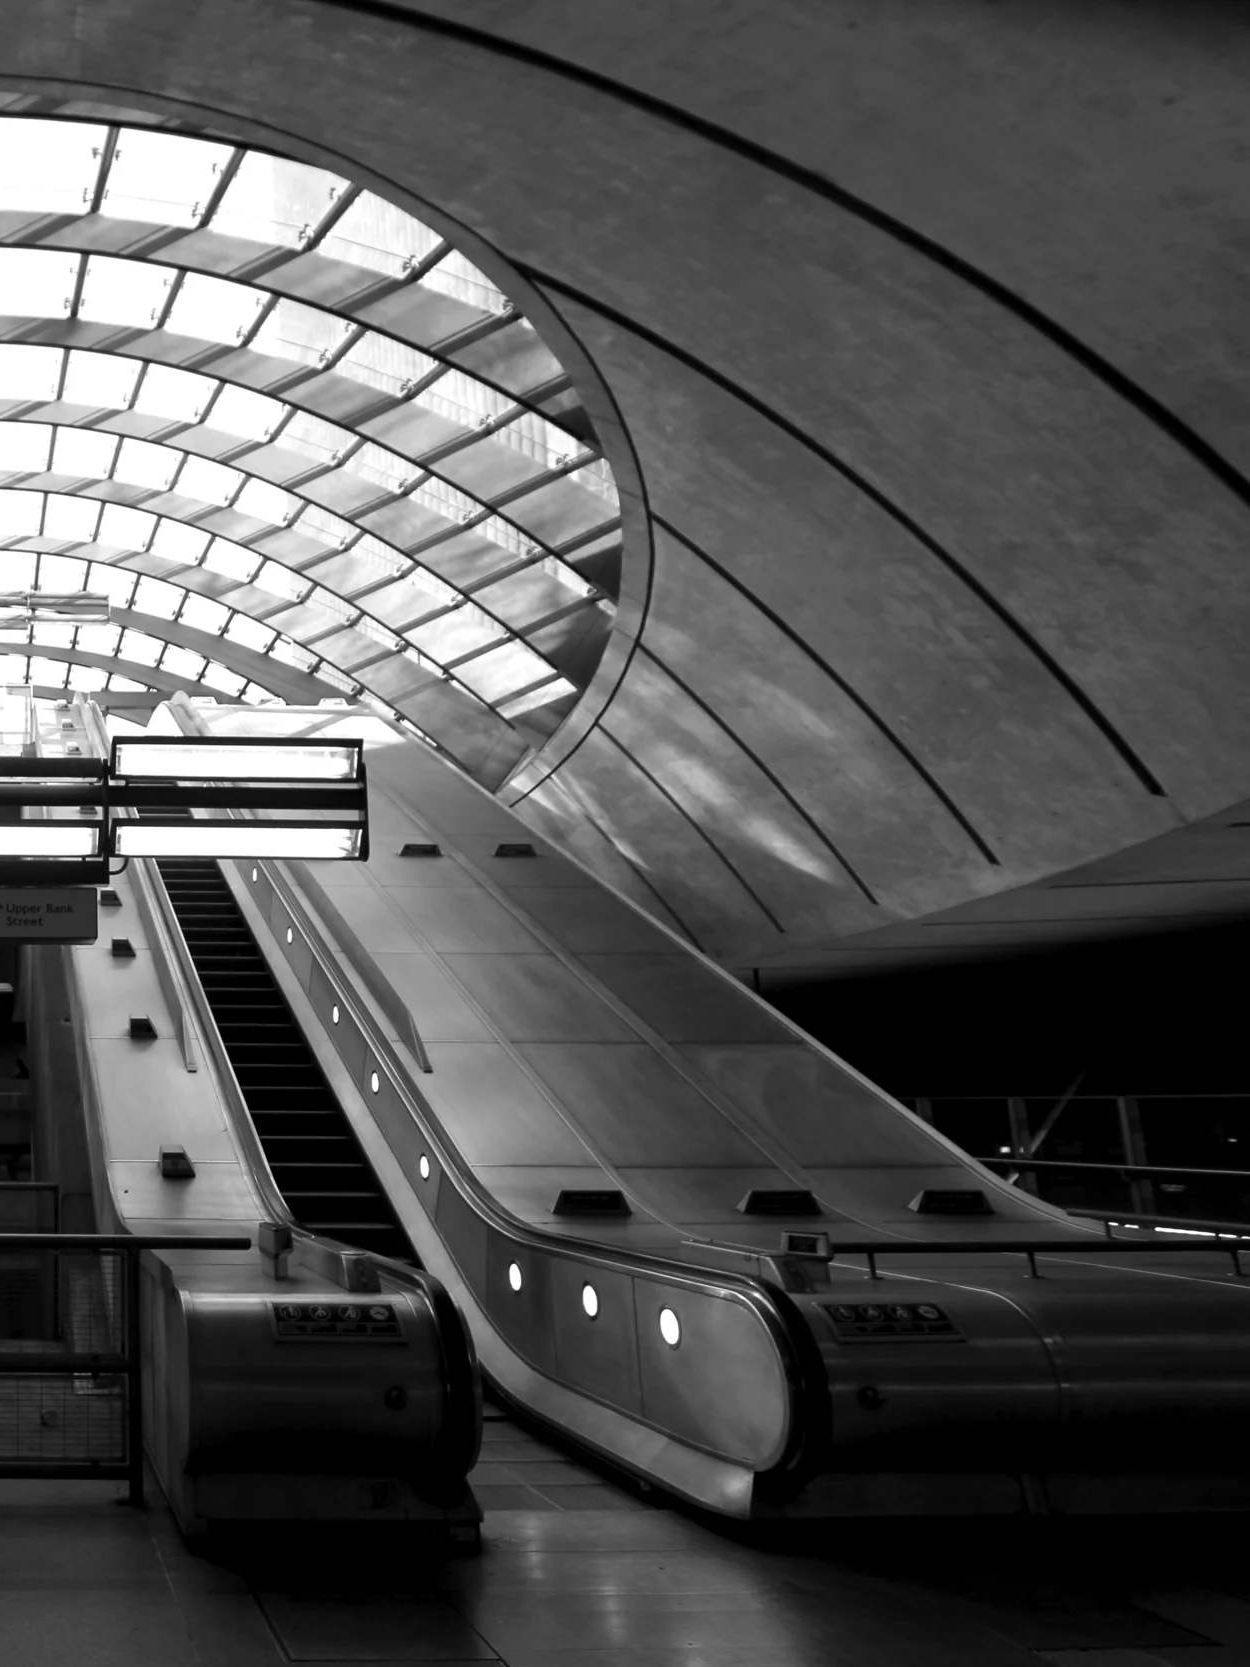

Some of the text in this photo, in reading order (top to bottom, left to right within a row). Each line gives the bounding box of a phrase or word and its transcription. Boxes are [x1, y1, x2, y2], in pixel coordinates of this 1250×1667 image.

[6, 903, 73, 915] Upper Bank
[6, 916, 43, 927] Street
